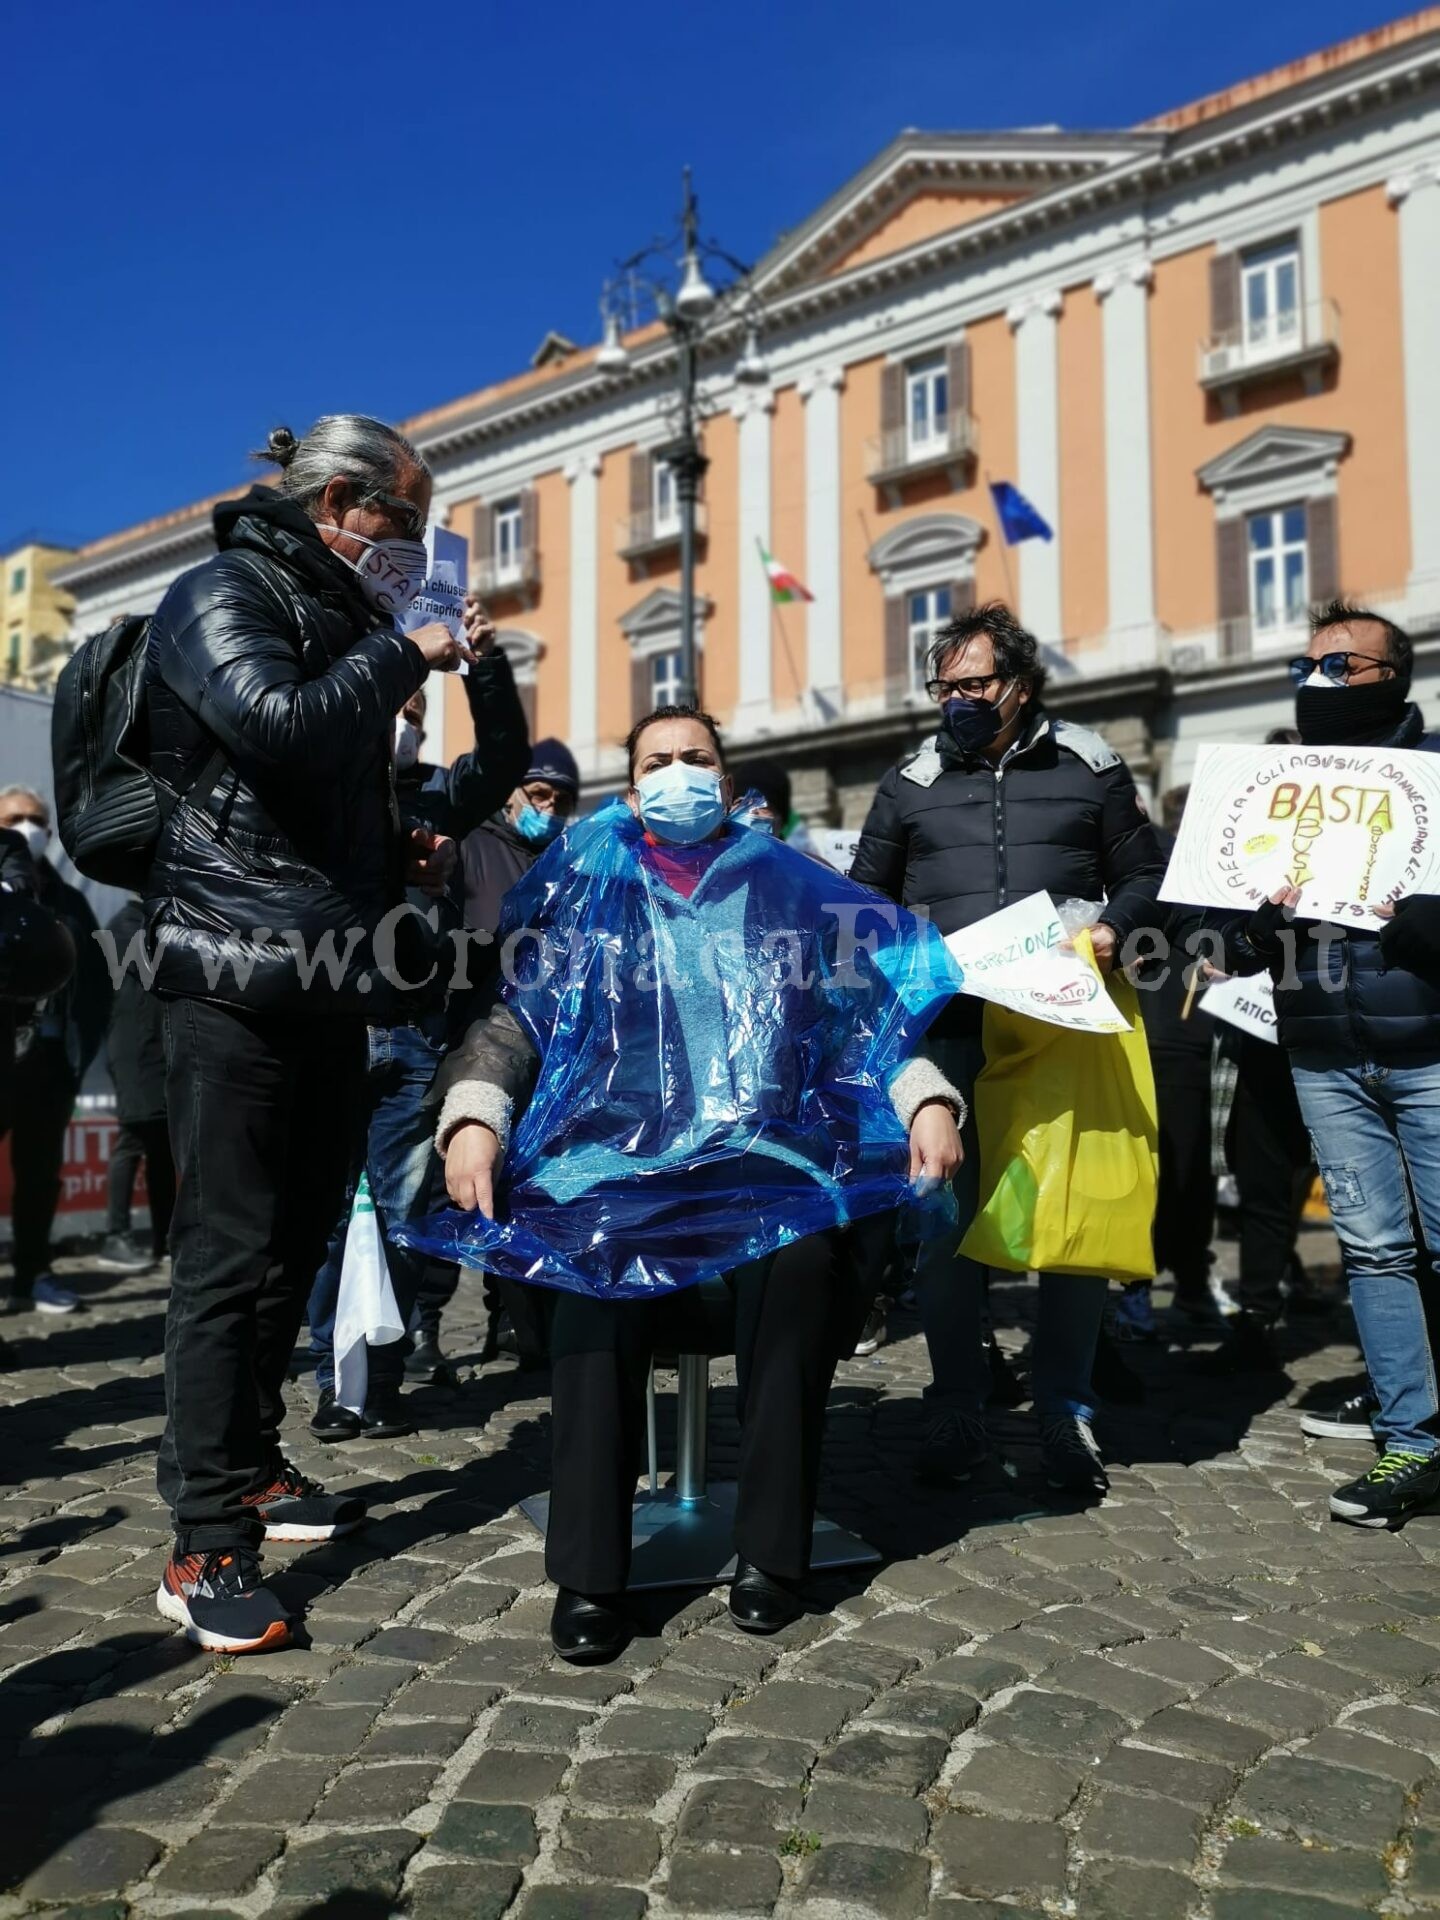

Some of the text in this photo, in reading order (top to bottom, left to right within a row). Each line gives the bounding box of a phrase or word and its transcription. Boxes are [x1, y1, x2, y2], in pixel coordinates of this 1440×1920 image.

[426, 600, 463, 618] riaprire
[1256, 760, 1285, 786] GLI
[1290, 754, 1374, 774] ABUSIVI
[1267, 782, 1392, 831] BASTA
